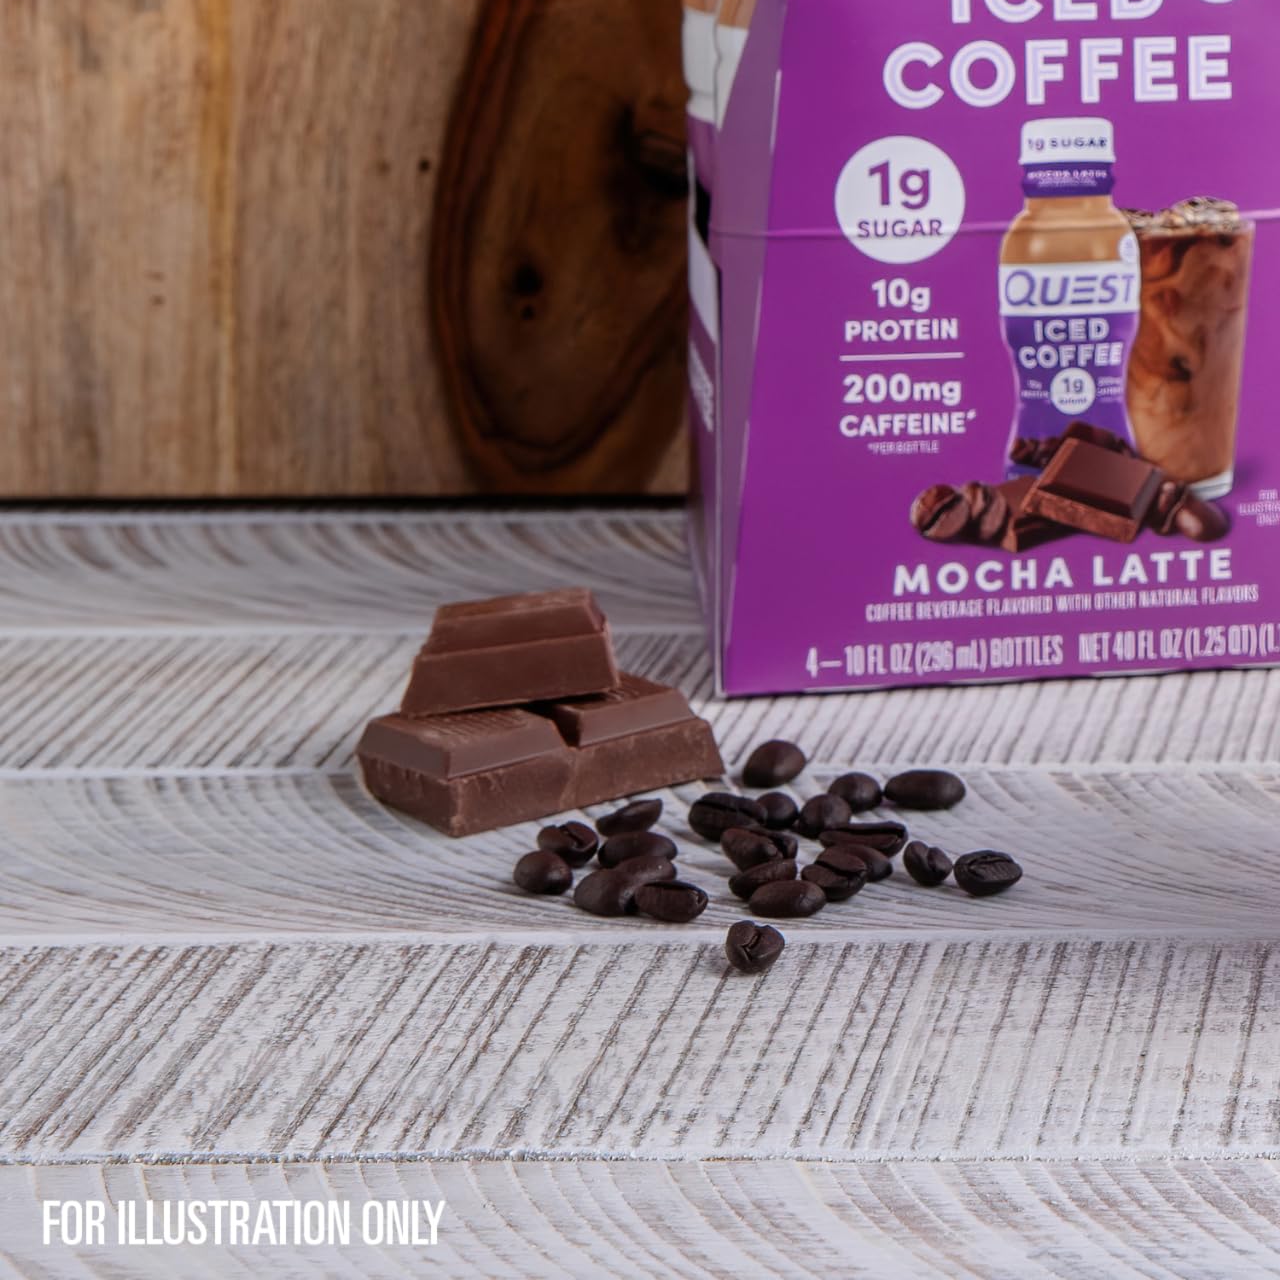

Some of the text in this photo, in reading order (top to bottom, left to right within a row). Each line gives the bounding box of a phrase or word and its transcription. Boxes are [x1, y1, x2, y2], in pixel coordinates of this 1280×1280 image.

[883, 35, 1232, 109] COFFEE
[1051, 136, 1107, 149] SUGAR
[868, 160, 930, 210] 1g
[857, 219, 943, 238] SUGAR
[871, 278, 931, 312] 10g
[1005, 269, 1134, 306] QUEST
[845, 318, 959, 342] PROTEIN
[1033, 317, 1110, 343] ICED
[1018, 341, 1124, 369] COFFEE
[842, 373, 962, 406] 200mg
[893, 548, 1233, 596] MOCHA LATTE
[865, 583, 1259, 622] COFFEE BEVERAGE FLAVORED WITH OTHER NATURAL FLAVORS
[867, 643, 888, 675] FL
[890, 642, 913, 674] OZ
[990, 634, 1064, 668] BOTTLES
[1078, 631, 1110, 663] NET
[1112, 630, 1135, 661] 40
[1138, 629, 1157, 660] FL
[1159, 628, 1184, 659] OZ
